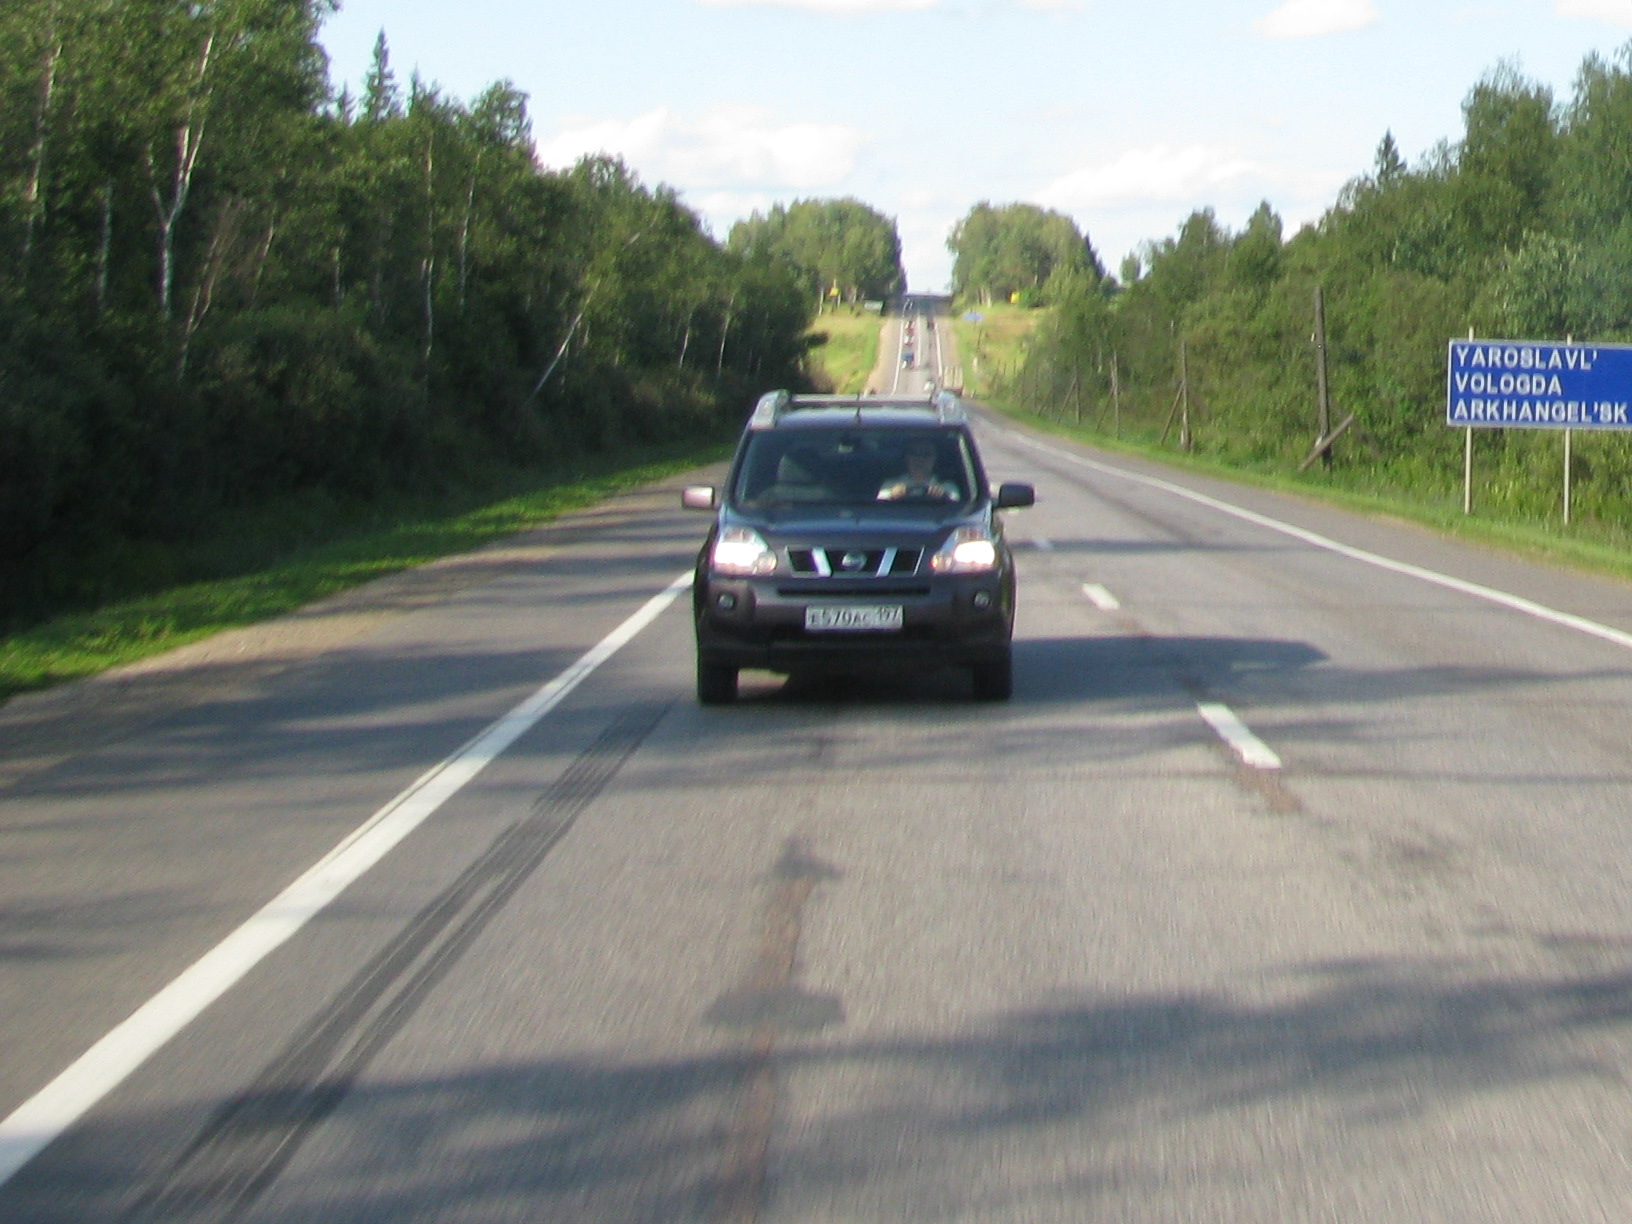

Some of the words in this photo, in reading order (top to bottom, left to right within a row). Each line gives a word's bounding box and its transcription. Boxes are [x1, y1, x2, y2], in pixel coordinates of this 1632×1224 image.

[1456, 346, 1598, 370] YAROSLAVL'
[1455, 372, 1563, 395] VOLOGDA
[1454, 398, 1628, 423] ARKHANGEL'SK
